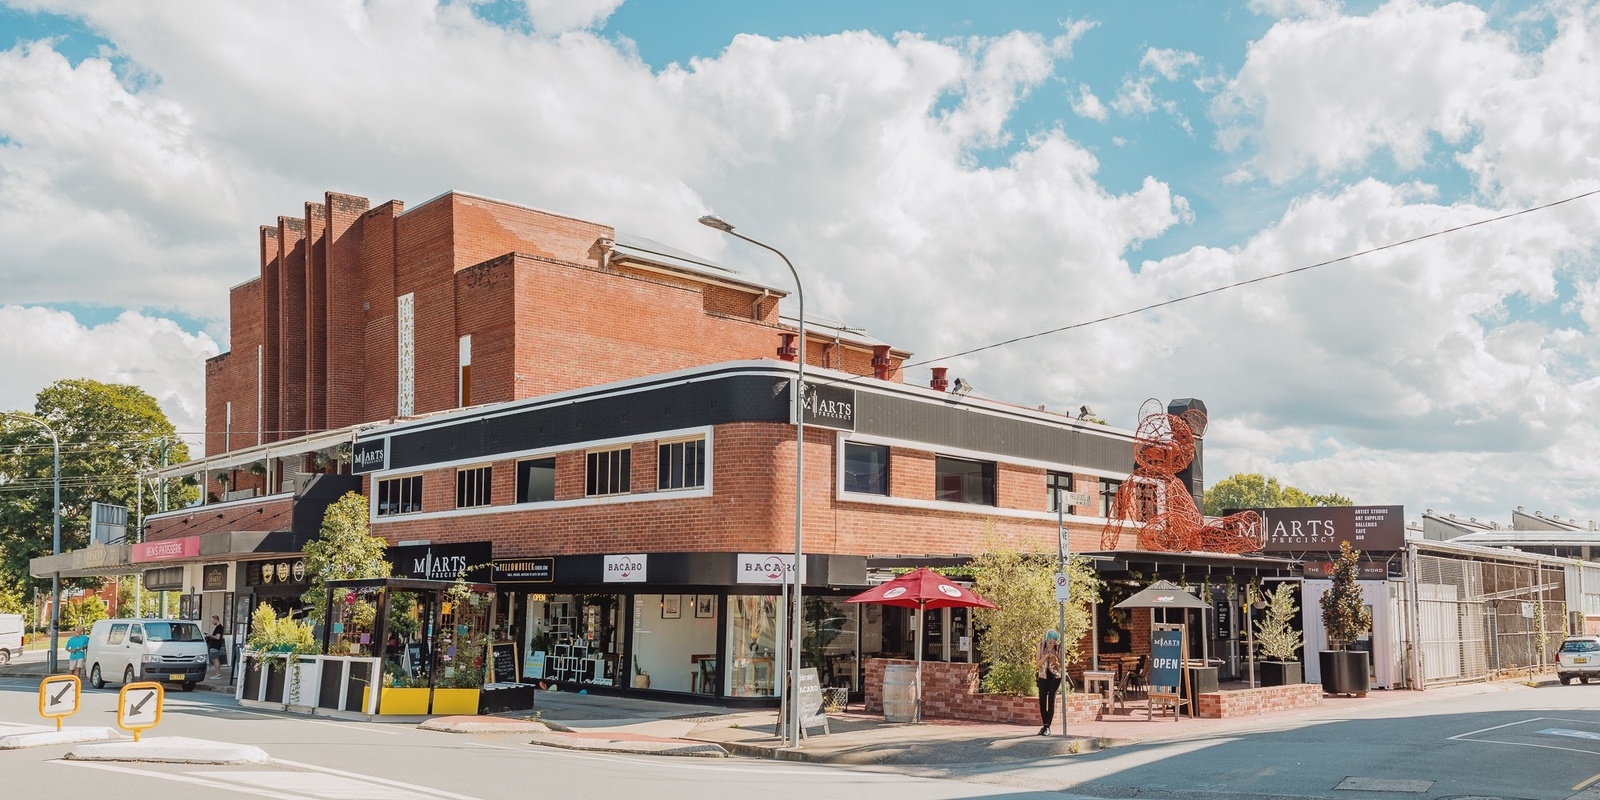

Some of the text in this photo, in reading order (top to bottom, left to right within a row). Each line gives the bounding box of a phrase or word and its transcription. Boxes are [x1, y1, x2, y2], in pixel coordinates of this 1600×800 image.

[818, 399, 852, 416] ARTS
[818, 411, 851, 420] PRECINCT
[365, 450, 384, 462] ARTS
[1271, 520, 1335, 537] ARTS
[159, 543, 182, 555] PATISSERIE
[431, 556, 466, 572] ARTS
[608, 563, 642, 571] BACARO
[533, 593, 546, 601] OPEN
[1153, 658, 1178, 669] OPEN
[799, 685, 819, 693] ACARO
